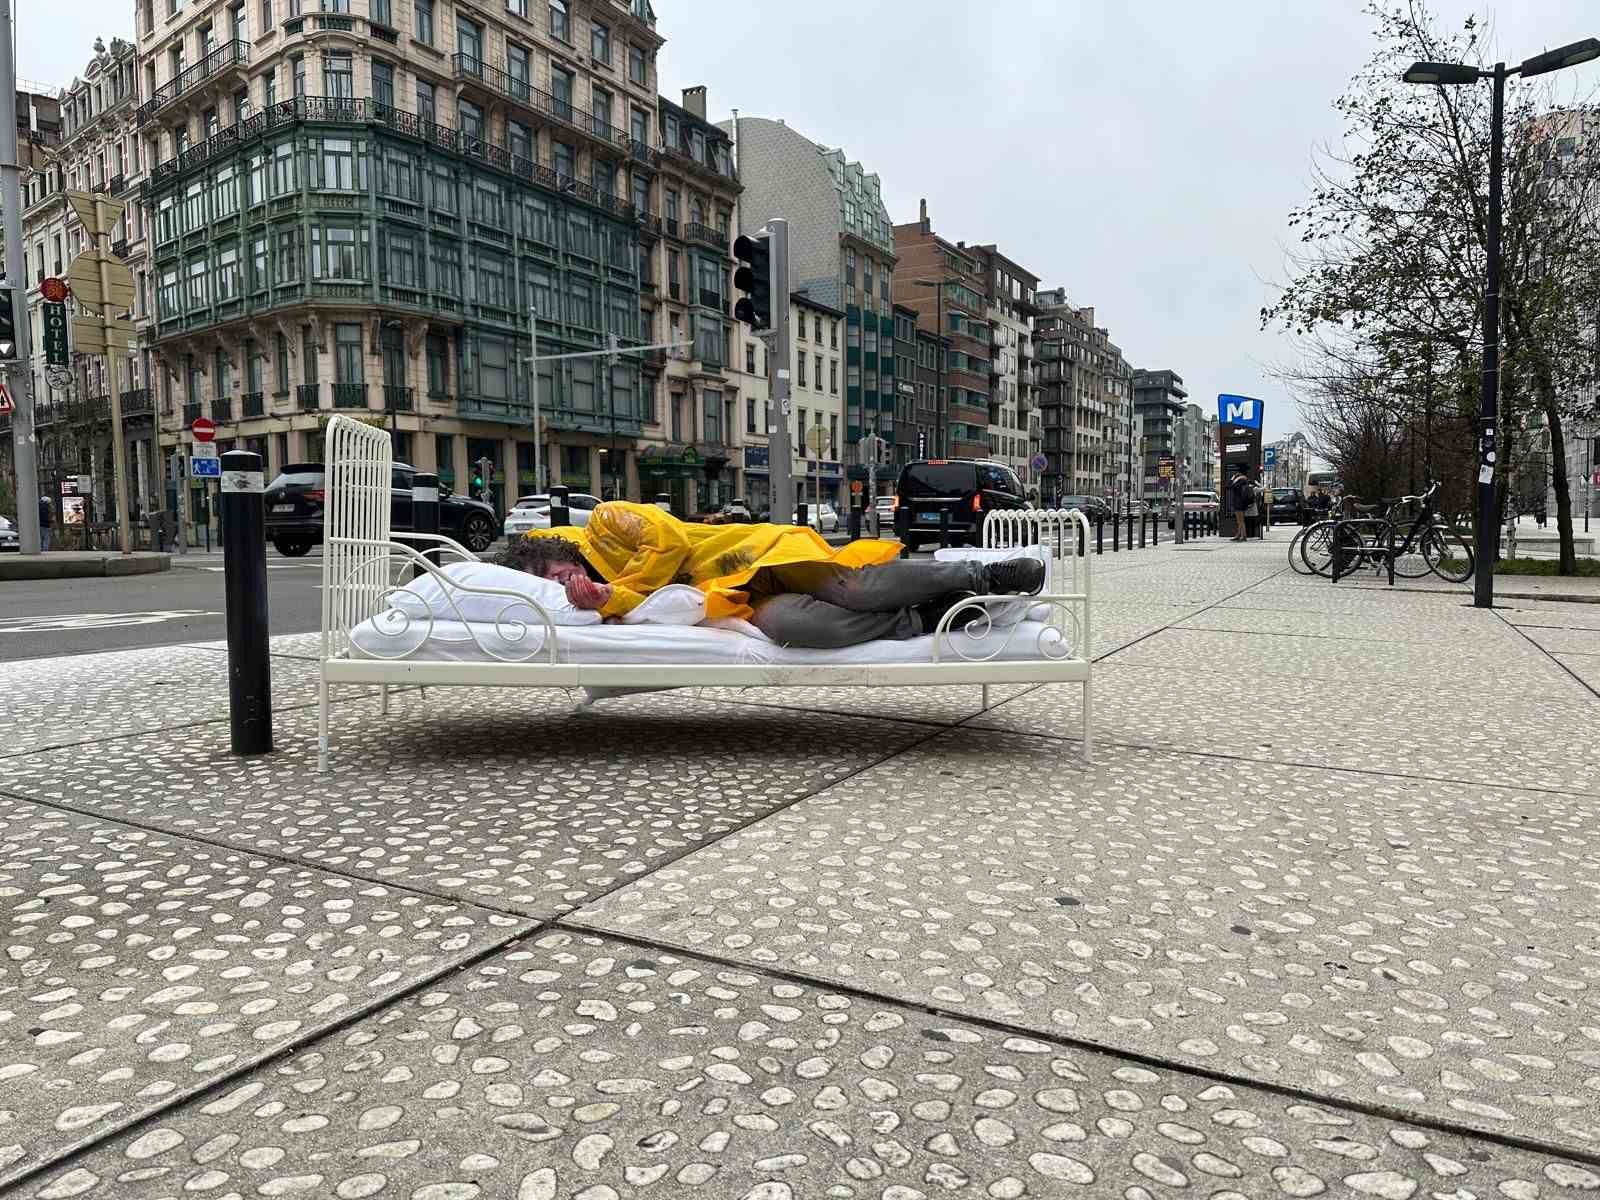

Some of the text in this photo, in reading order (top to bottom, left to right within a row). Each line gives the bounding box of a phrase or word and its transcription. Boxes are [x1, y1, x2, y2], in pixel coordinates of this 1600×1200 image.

[49, 305, 62, 362] HOTEL
[1227, 401, 1253, 422] M
[1265, 451, 1274, 463] P
